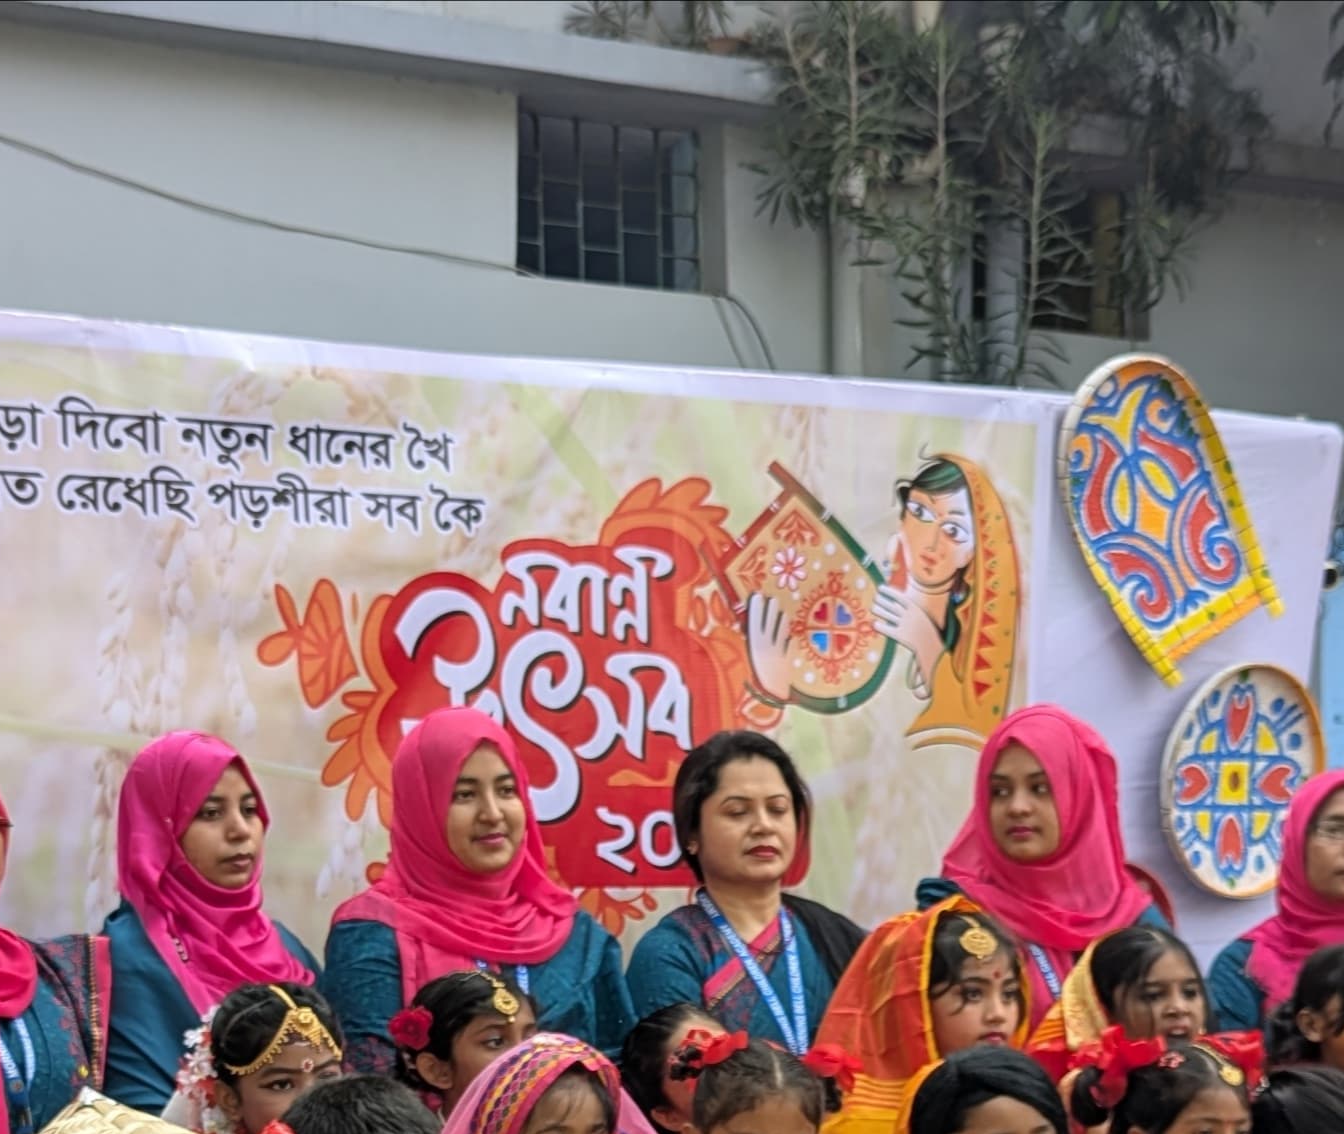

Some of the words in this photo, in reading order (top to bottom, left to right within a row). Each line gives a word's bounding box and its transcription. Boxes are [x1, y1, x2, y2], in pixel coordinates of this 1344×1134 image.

[55, 396, 165, 454] দিবো
[176, 417, 273, 470] নতুন
[289, 424, 395, 469] ধানের
[404, 421, 454, 473] খৈ
[56, 465, 195, 521] রেধেছি
[207, 472, 352, 528] পড়শীরা
[361, 492, 422, 532] সব
[430, 484, 486, 533] কৈ
[499, 544, 675, 645] নবান্ন
[595, 806, 683, 874] ২০
